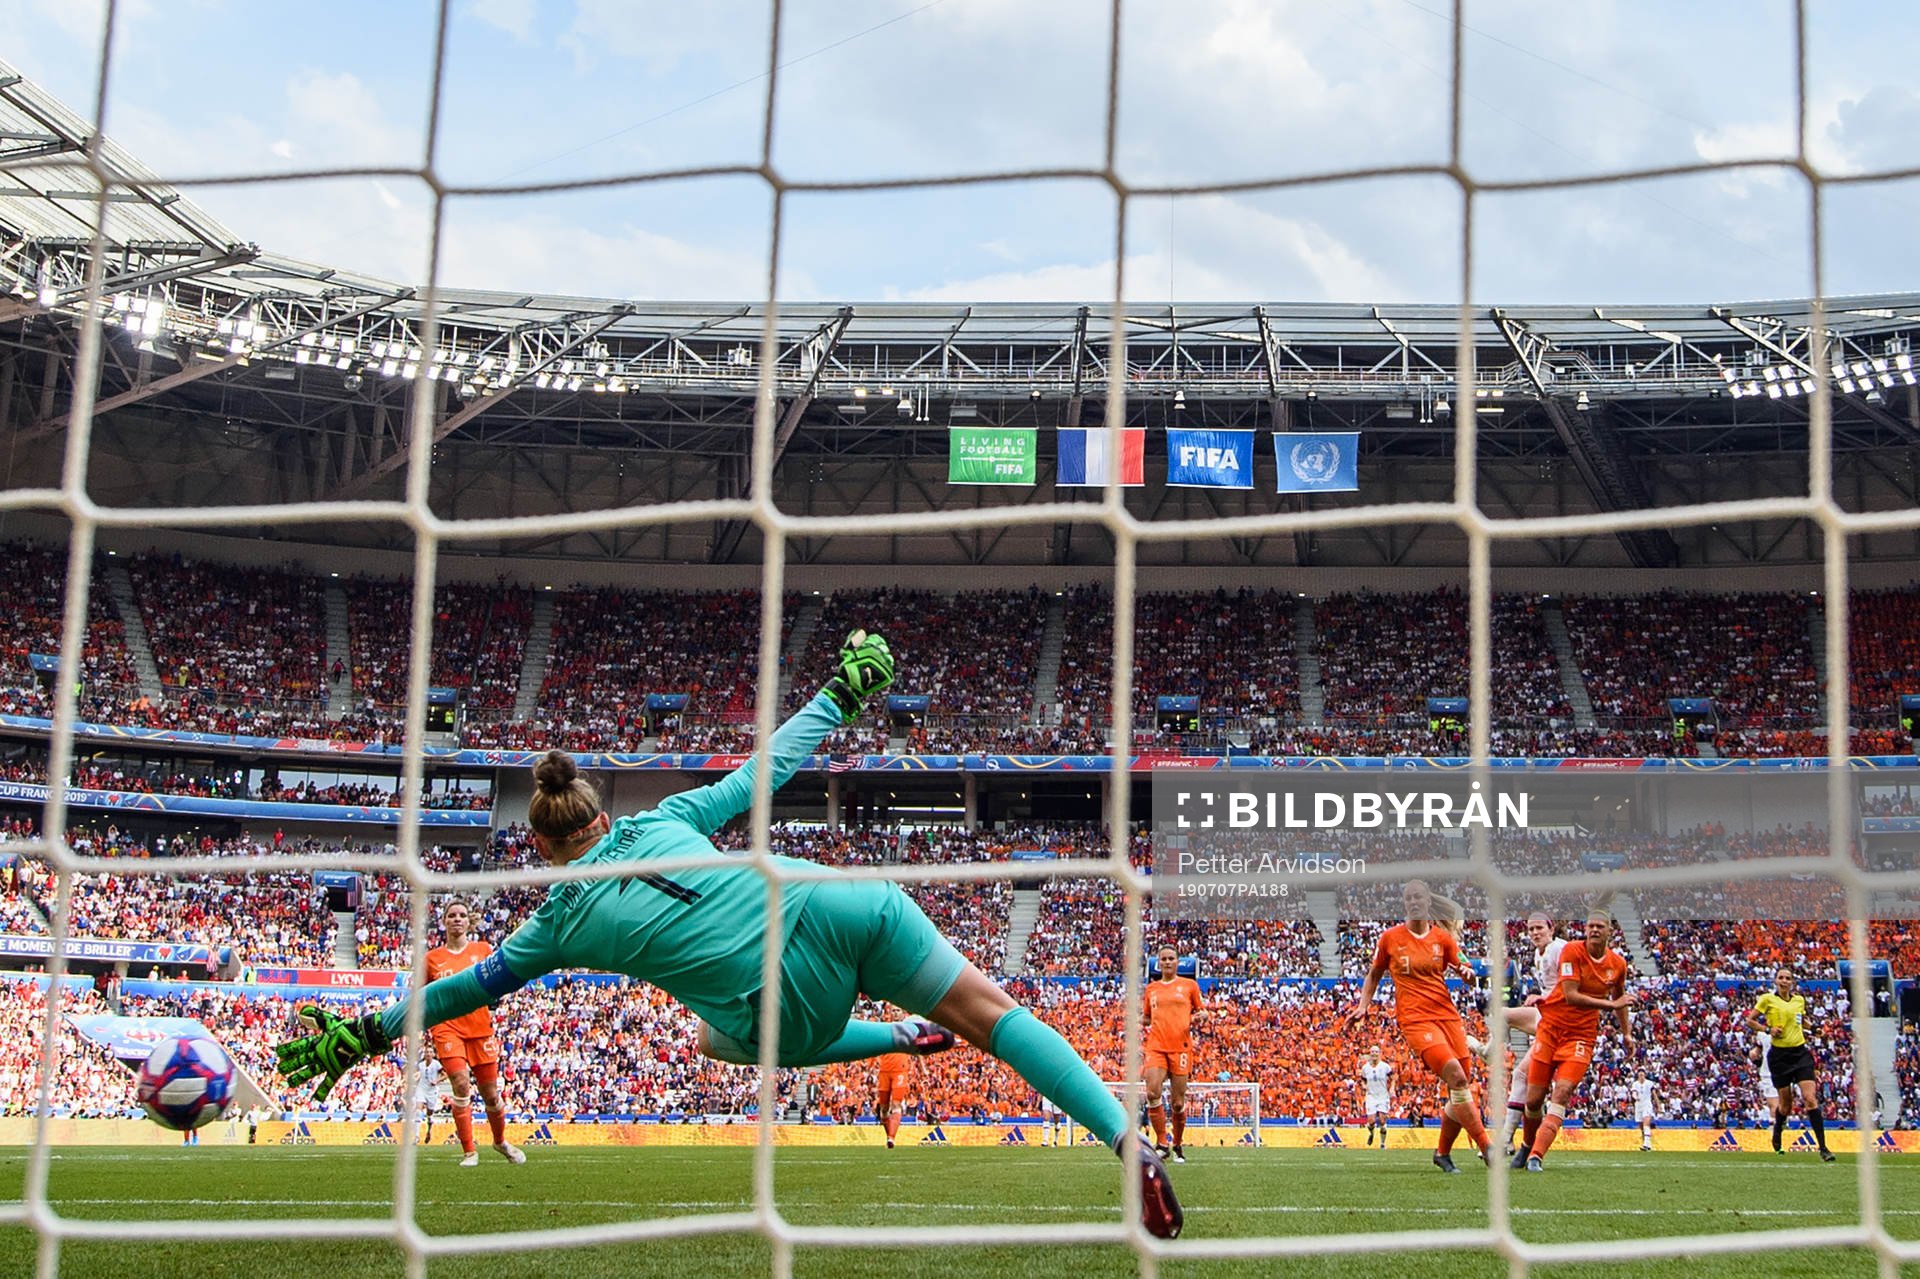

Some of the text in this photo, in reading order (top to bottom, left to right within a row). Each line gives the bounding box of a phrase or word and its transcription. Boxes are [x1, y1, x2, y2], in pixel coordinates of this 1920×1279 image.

[960, 437, 1025, 446] LIVING
[960, 446, 1024, 455] FOOTBALL
[1180, 446, 1240, 471] FIFA
[994, 464, 1024, 475] FIFA
[66, 943, 82, 955] DE
[84, 945, 132, 957] BRILLER
[1400, 955, 1410, 975] 3
[331, 973, 364, 985] LYON
[280, 1135, 316, 1145] addas
